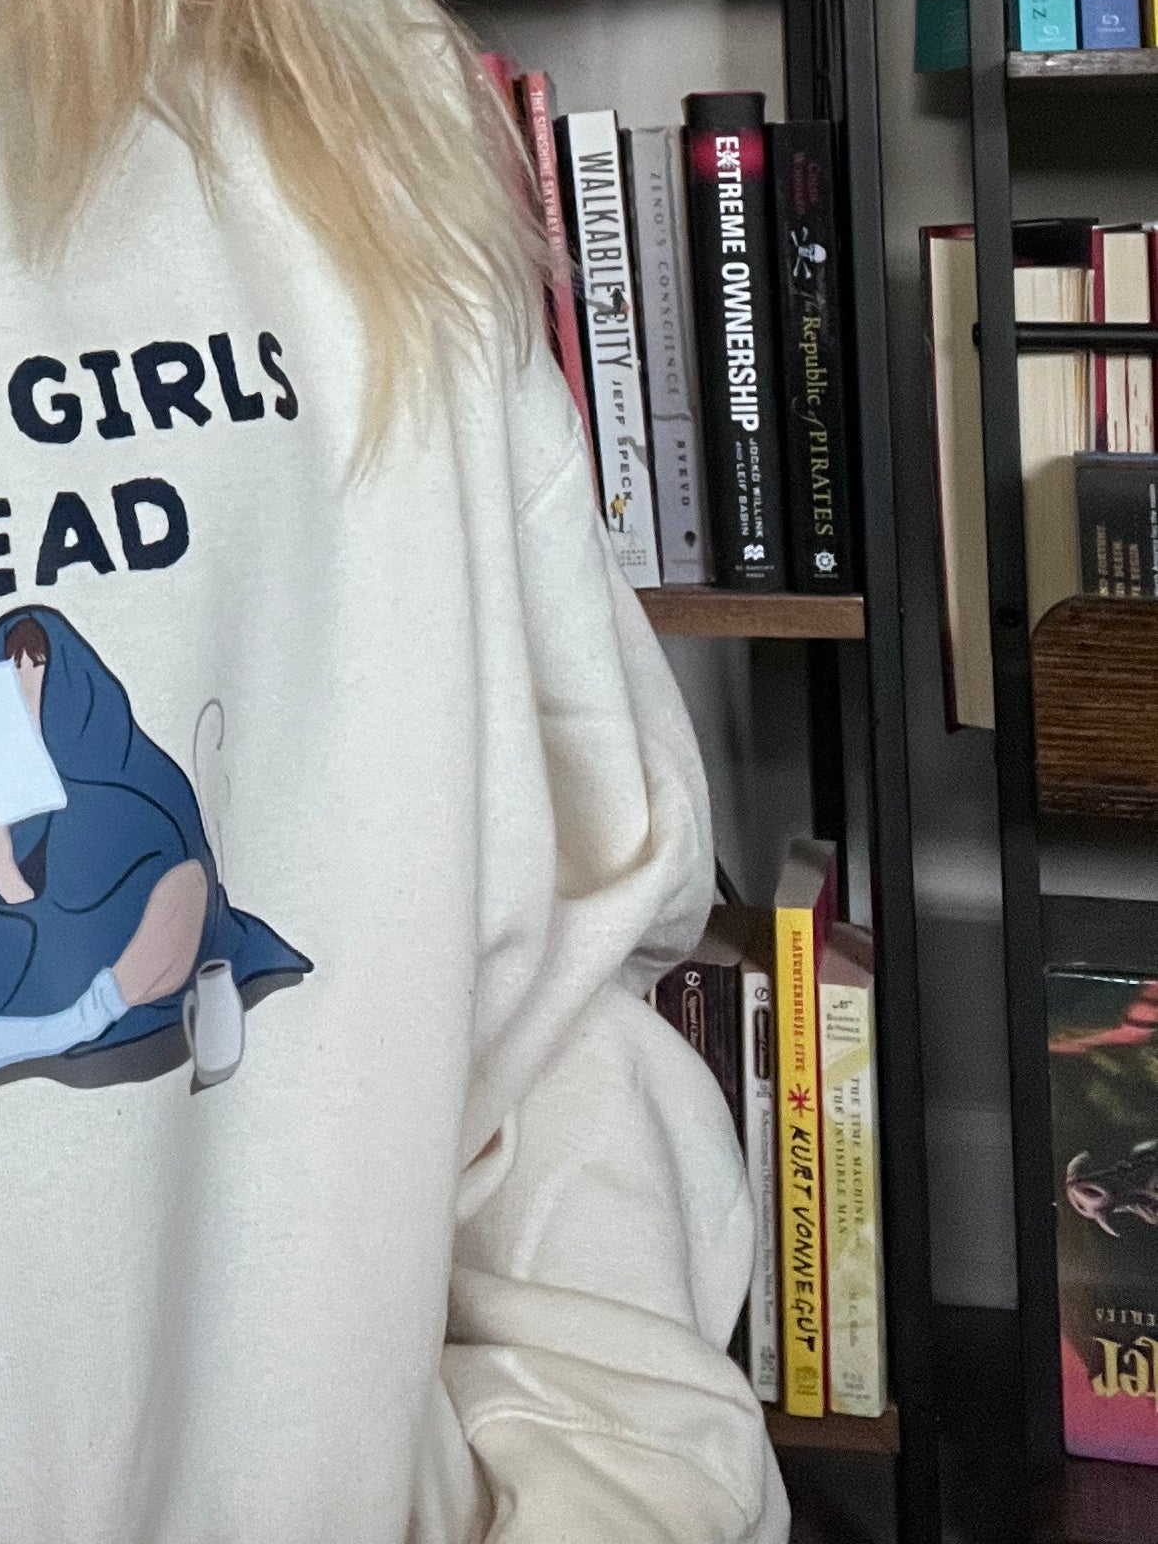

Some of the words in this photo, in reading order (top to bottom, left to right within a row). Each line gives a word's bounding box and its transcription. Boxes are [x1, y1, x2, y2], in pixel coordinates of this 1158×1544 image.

[531, 90, 545, 113] THE
[533, 114, 552, 179] SUNSHINE
[578, 150, 626, 295] WALKABLE
[651, 171, 668, 248] ZENO'S
[714, 135, 747, 255] EXTREME
[593, 309, 633, 369] CITY
[656, 260, 681, 397] CONSCIENCE
[720, 261, 760, 432] OWNERSHIP
[799, 314, 829, 405] Republic
[6, 329, 302, 446] GIRLS
[612, 380, 626, 426] JEFF
[616, 436, 634, 502] SPECK
[675, 439, 692, 507] SVEVO
[736, 462, 748, 492] LEIF
[748, 437, 762, 483] JOCKO
[809, 429, 835, 537] PIRATES
[738, 495, 750, 537] BABIN
[752, 486, 764, 539] WILLINK
[833, 1085, 845, 1114] THE
[850, 1077, 861, 1105] THE
[789, 1124, 815, 1200] KURT
[834, 1121, 847, 1197] INVISIBLE
[850, 1113, 862, 1148] TIME
[837, 1206, 848, 1235] MAN
[852, 1156, 865, 1226] MACHINE
[792, 1207, 819, 1353] VONNEGUT
